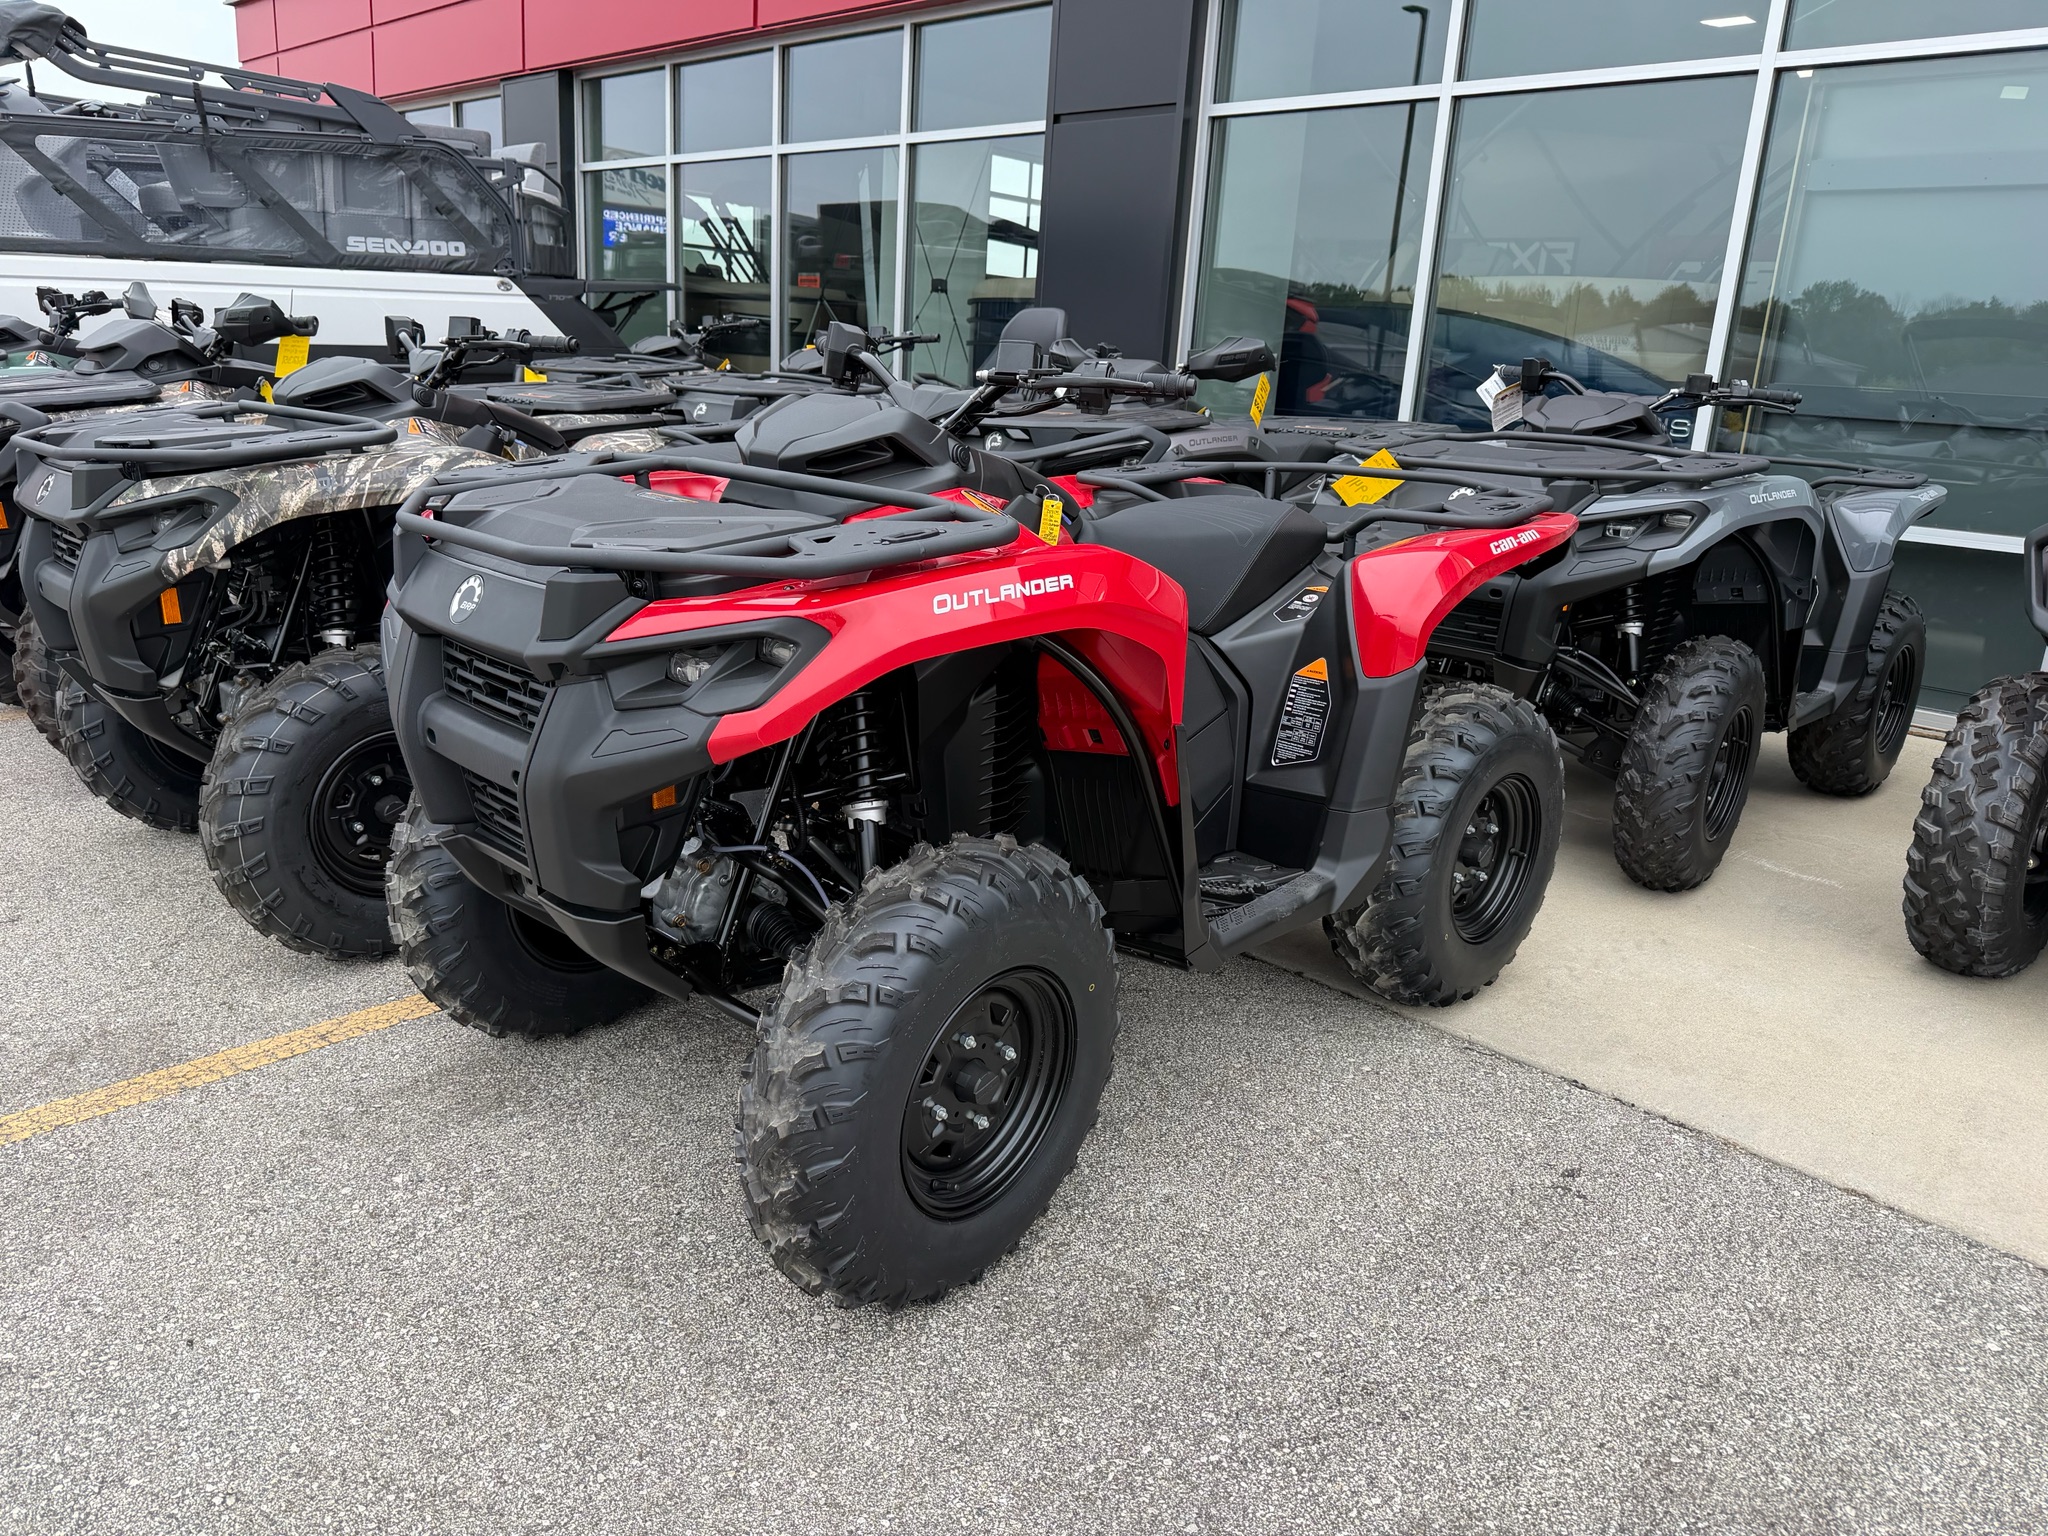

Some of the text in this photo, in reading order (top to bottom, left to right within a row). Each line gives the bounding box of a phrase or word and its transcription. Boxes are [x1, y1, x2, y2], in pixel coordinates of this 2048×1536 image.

[1189, 435, 1238, 447] OUTLANDER
[1750, 489, 1797, 504] OUTLANDER
[1489, 528, 1541, 555] can-am
[933, 574, 1074, 614] OUTLANDER
[460, 600, 477, 611] BRP
